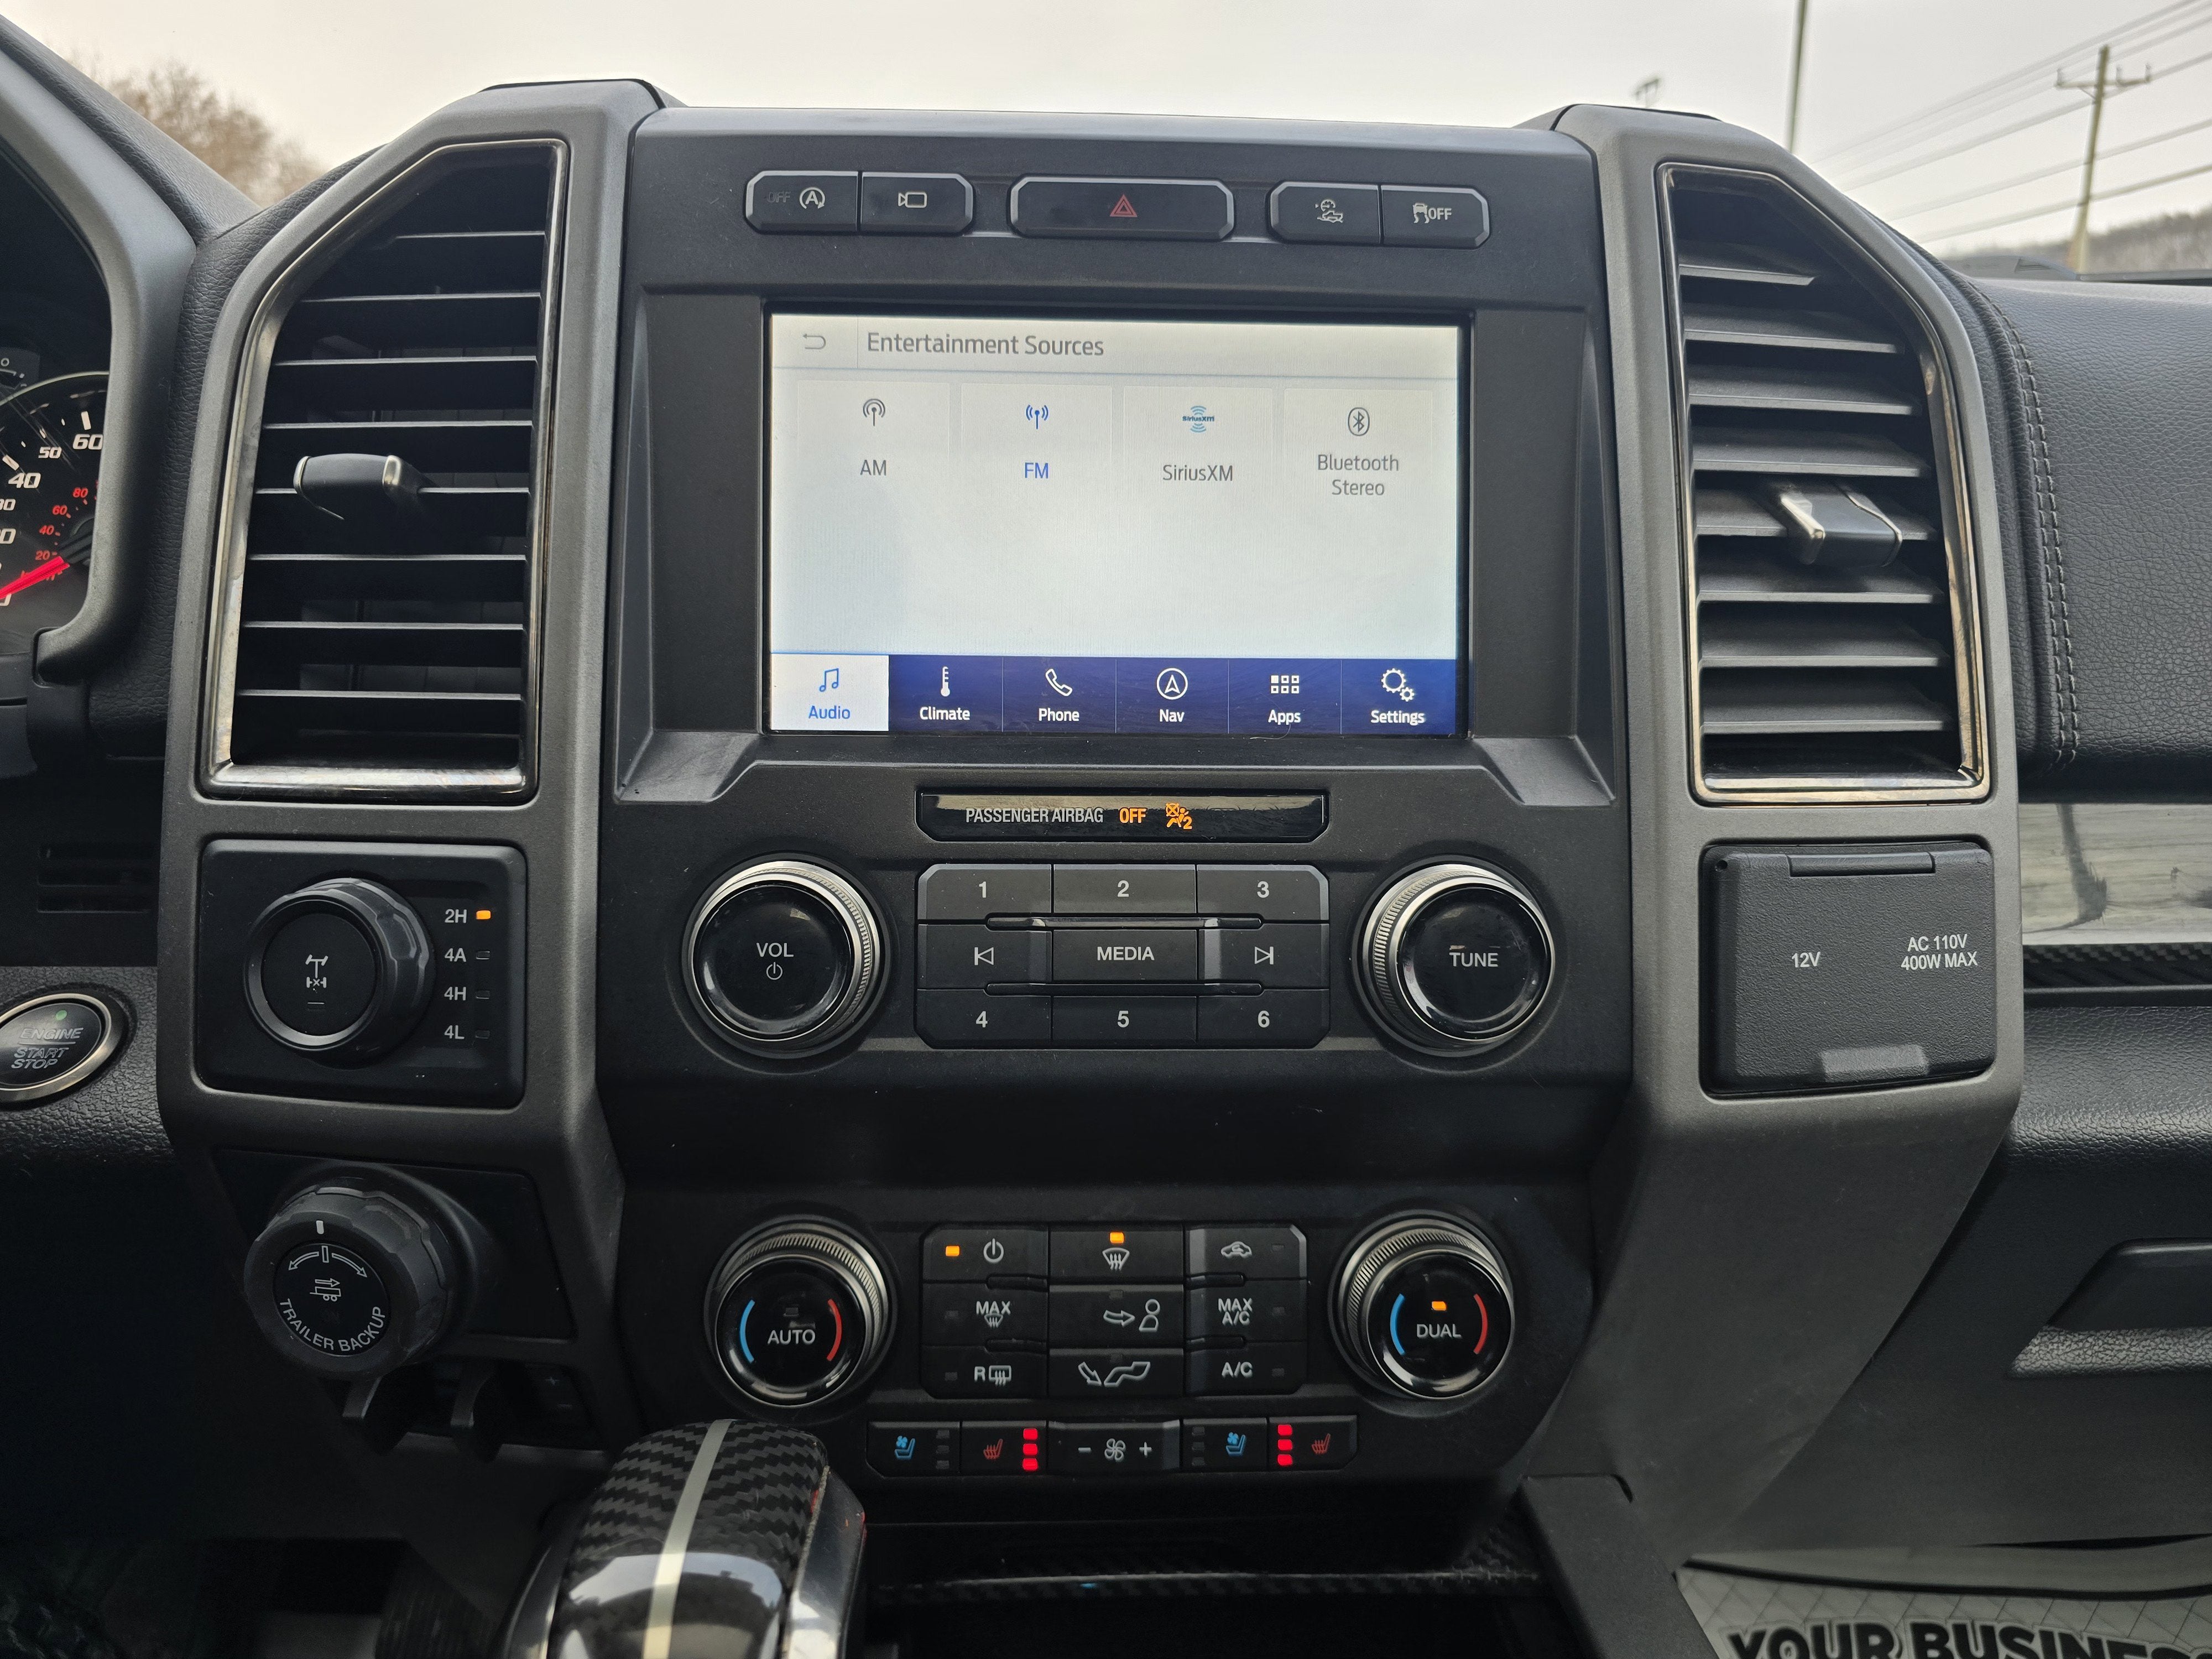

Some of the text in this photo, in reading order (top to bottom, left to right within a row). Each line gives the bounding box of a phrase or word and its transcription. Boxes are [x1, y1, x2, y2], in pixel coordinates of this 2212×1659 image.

[767, 191, 791, 203] OFF
[1428, 208, 1452, 220] OFF
[868, 332, 1103, 356] Entertainment Sources
[73, 434, 103, 450] 60
[38, 446, 62, 458] 50
[860, 460, 886, 476] AM
[1025, 462, 1049, 479] FM
[1317, 454, 1400, 472] Bluetooth
[8, 473, 41, 488] 40
[1162, 465, 1233, 482] SiriusXM
[72, 488, 88, 498] 80
[1332, 479, 1385, 495] Stereo
[52, 505, 67, 515] 60
[0, 528, 16, 544] 0
[39, 525, 54, 535] 40
[35, 550, 50, 560] 20
[808, 705, 851, 720] Audio
[920, 706, 970, 721] Climate
[1039, 708, 1079, 722] Phone
[1159, 709, 1185, 723] Nav
[1268, 709, 1301, 726] Apps
[1371, 710, 1425, 726] Settings
[966, 807, 1146, 825] PASSENGER AIRBAG OFF
[979, 881, 987, 898] 1
[1117, 880, 1129, 898] 2
[1256, 881, 1270, 899] 3
[444, 909, 467, 924] 2H
[757, 942, 794, 957] VOL
[1907, 933, 1968, 952] AC 110V
[444, 948, 467, 962] 4A
[1097, 946, 1155, 961] MEDIA
[1449, 952, 1499, 968] TUNE
[1791, 952, 1821, 968] 12V
[1901, 951, 1978, 971] 400W MAX
[444, 986, 467, 1001] 4H
[975, 1010, 988, 1029] 4
[1117, 1010, 1130, 1029] 5
[1257, 1011, 1270, 1029] 6
[20, 1027, 84, 1040] ENGINE
[444, 1025, 465, 1040] 4L
[14, 1047, 69, 1058] START
[11, 1058, 58, 1069] STOP
[976, 1301, 1011, 1315] MAX
[1218, 1297, 1253, 1312] MAX
[279, 1298, 386, 1352] TRAILER BACKUP
[1222, 1311, 1251, 1326] A/C
[768, 1329, 816, 1344] AUTO
[1416, 1323, 1462, 1339] DUAL
[974, 1366, 986, 1381] R
[1222, 1361, 1253, 1378] A/C
[1726, 1621, 2212, 1659] YOUR BUSIN
